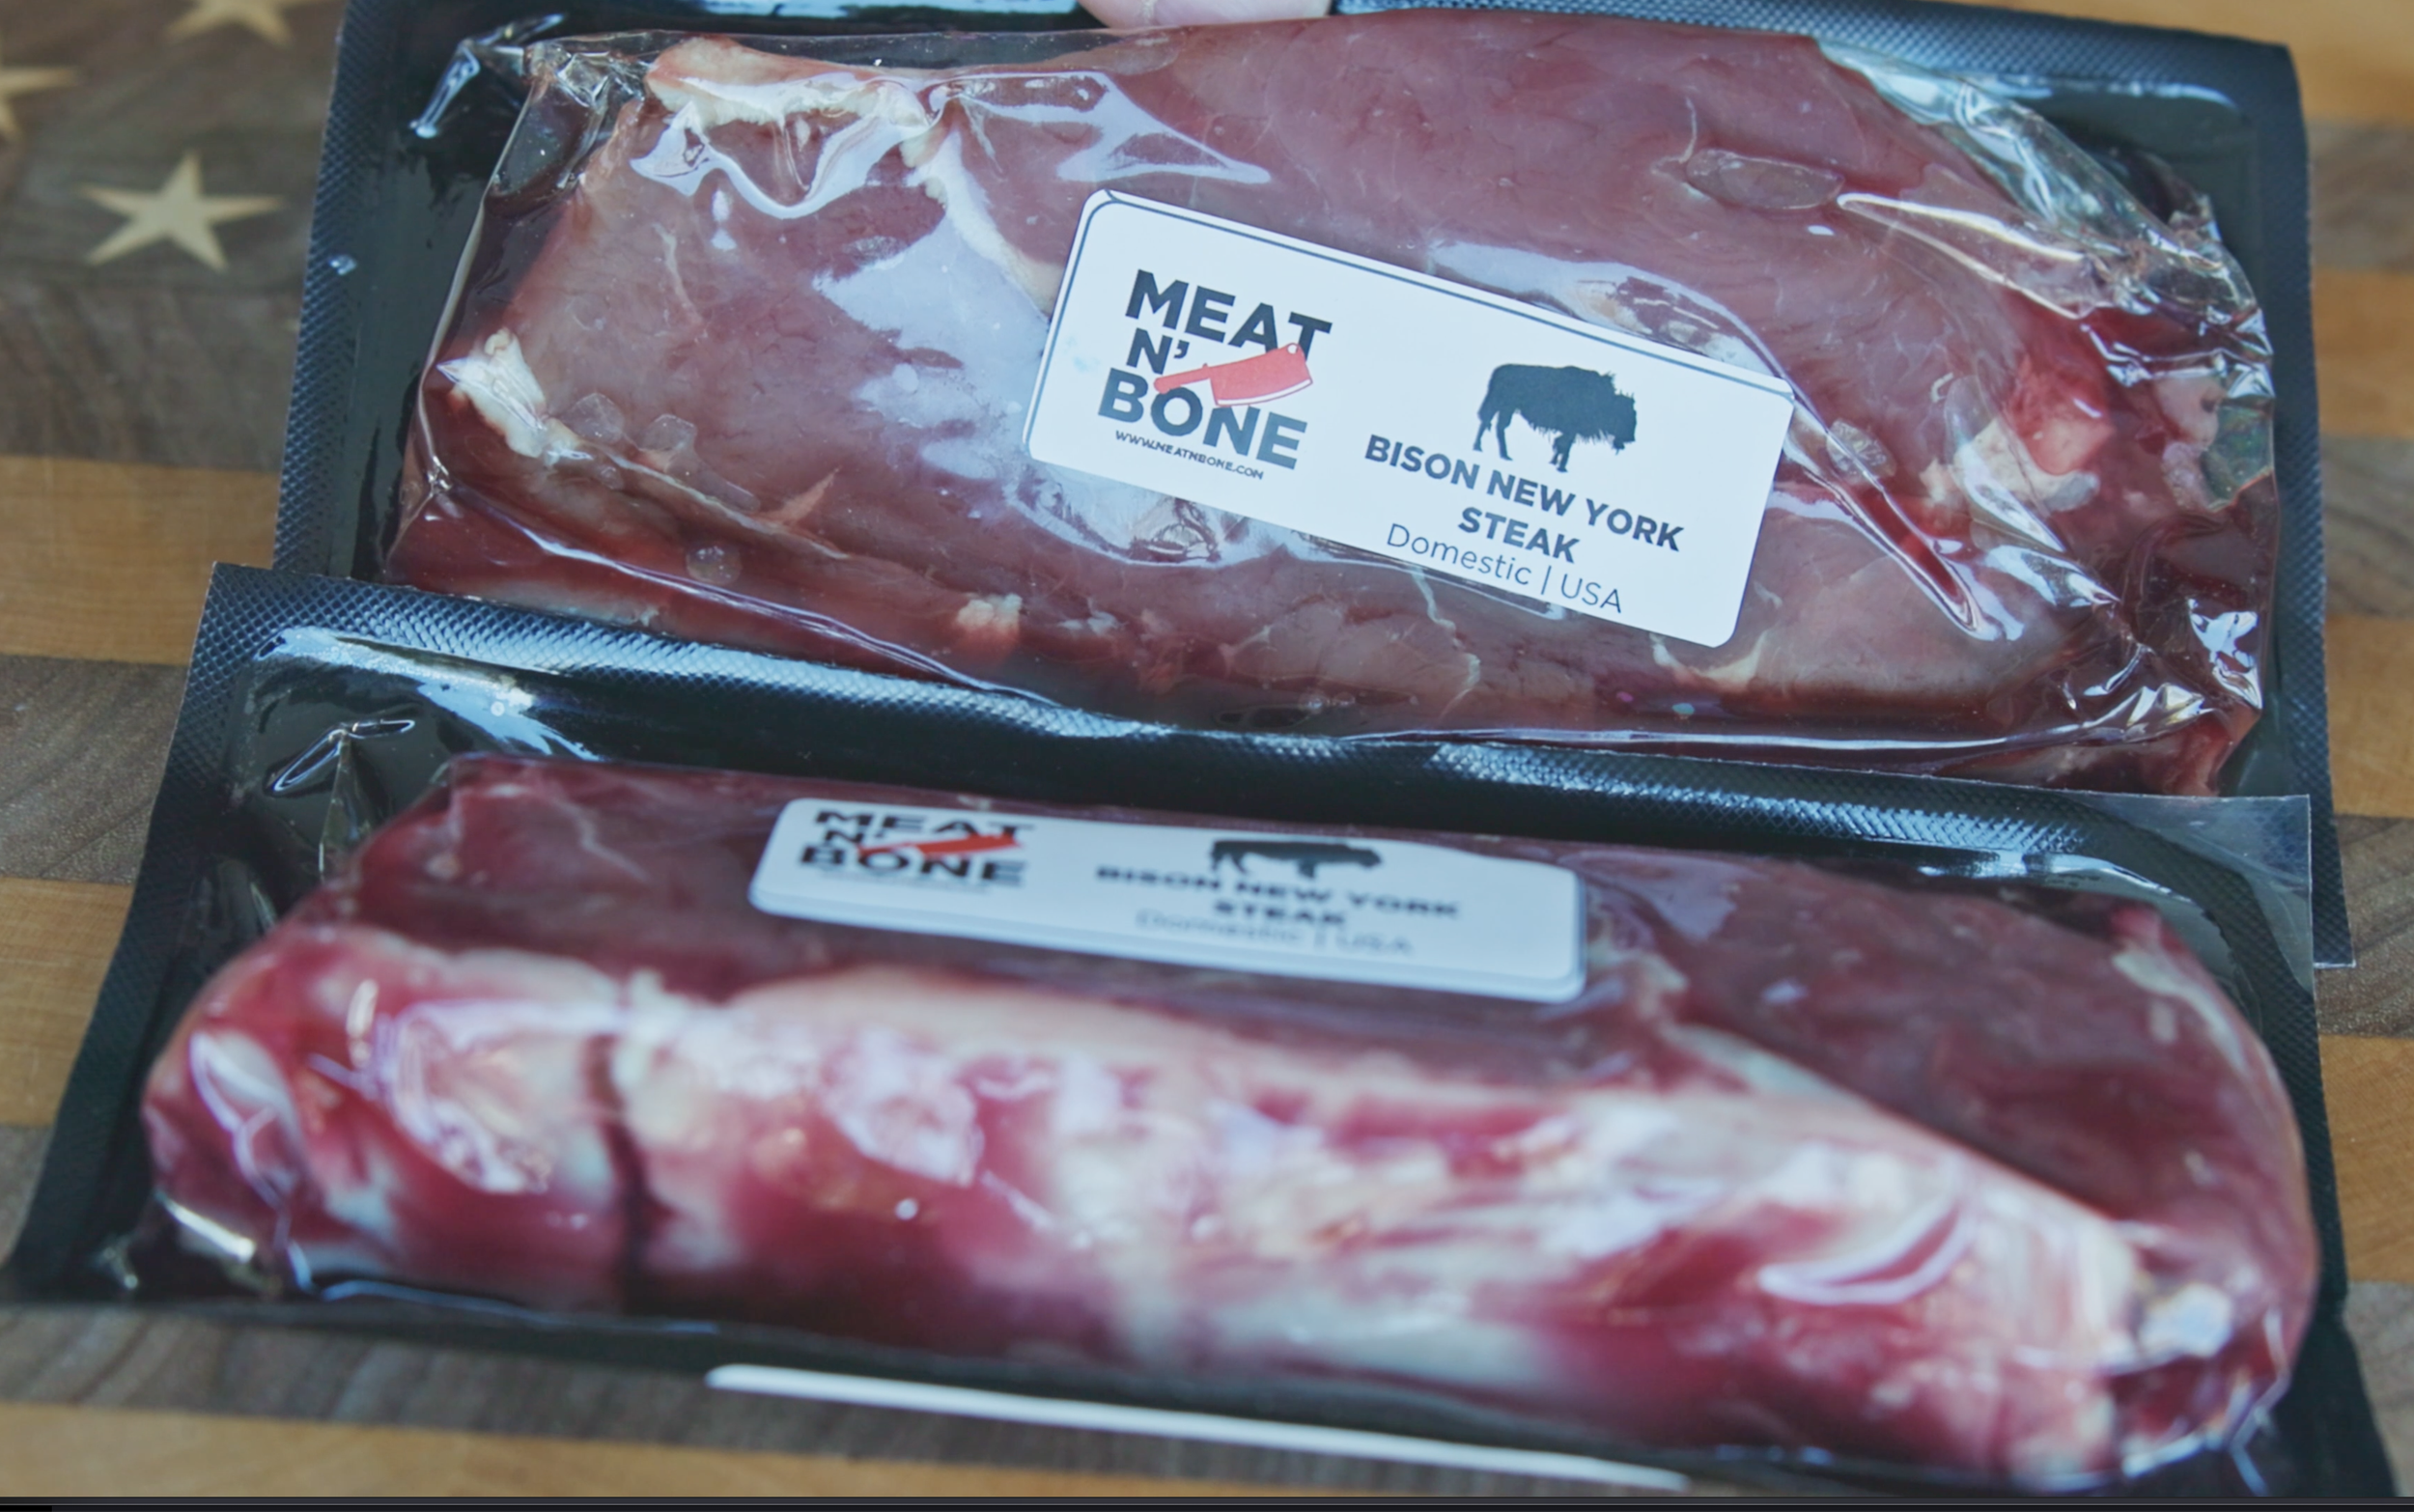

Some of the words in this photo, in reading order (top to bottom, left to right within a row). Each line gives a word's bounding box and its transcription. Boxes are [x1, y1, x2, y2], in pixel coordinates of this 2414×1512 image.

[1125, 268, 1333, 362] MEAT
[1098, 367, 1307, 470] BONE
[1364, 434, 1480, 490] BISON
[1486, 469, 1576, 517] NEW
[1586, 498, 1684, 551] YORK
[1458, 507, 1580, 564] STEAK
[1387, 523, 1532, 585] Domestic
[1560, 574, 1622, 613] USA
[816, 810, 1034, 838] MEAT
[800, 846, 1027, 886] BONE
[1096, 866, 1221, 890] BISON
[1235, 881, 1333, 903] NEW
[1213, 900, 1345, 926] STEAK
